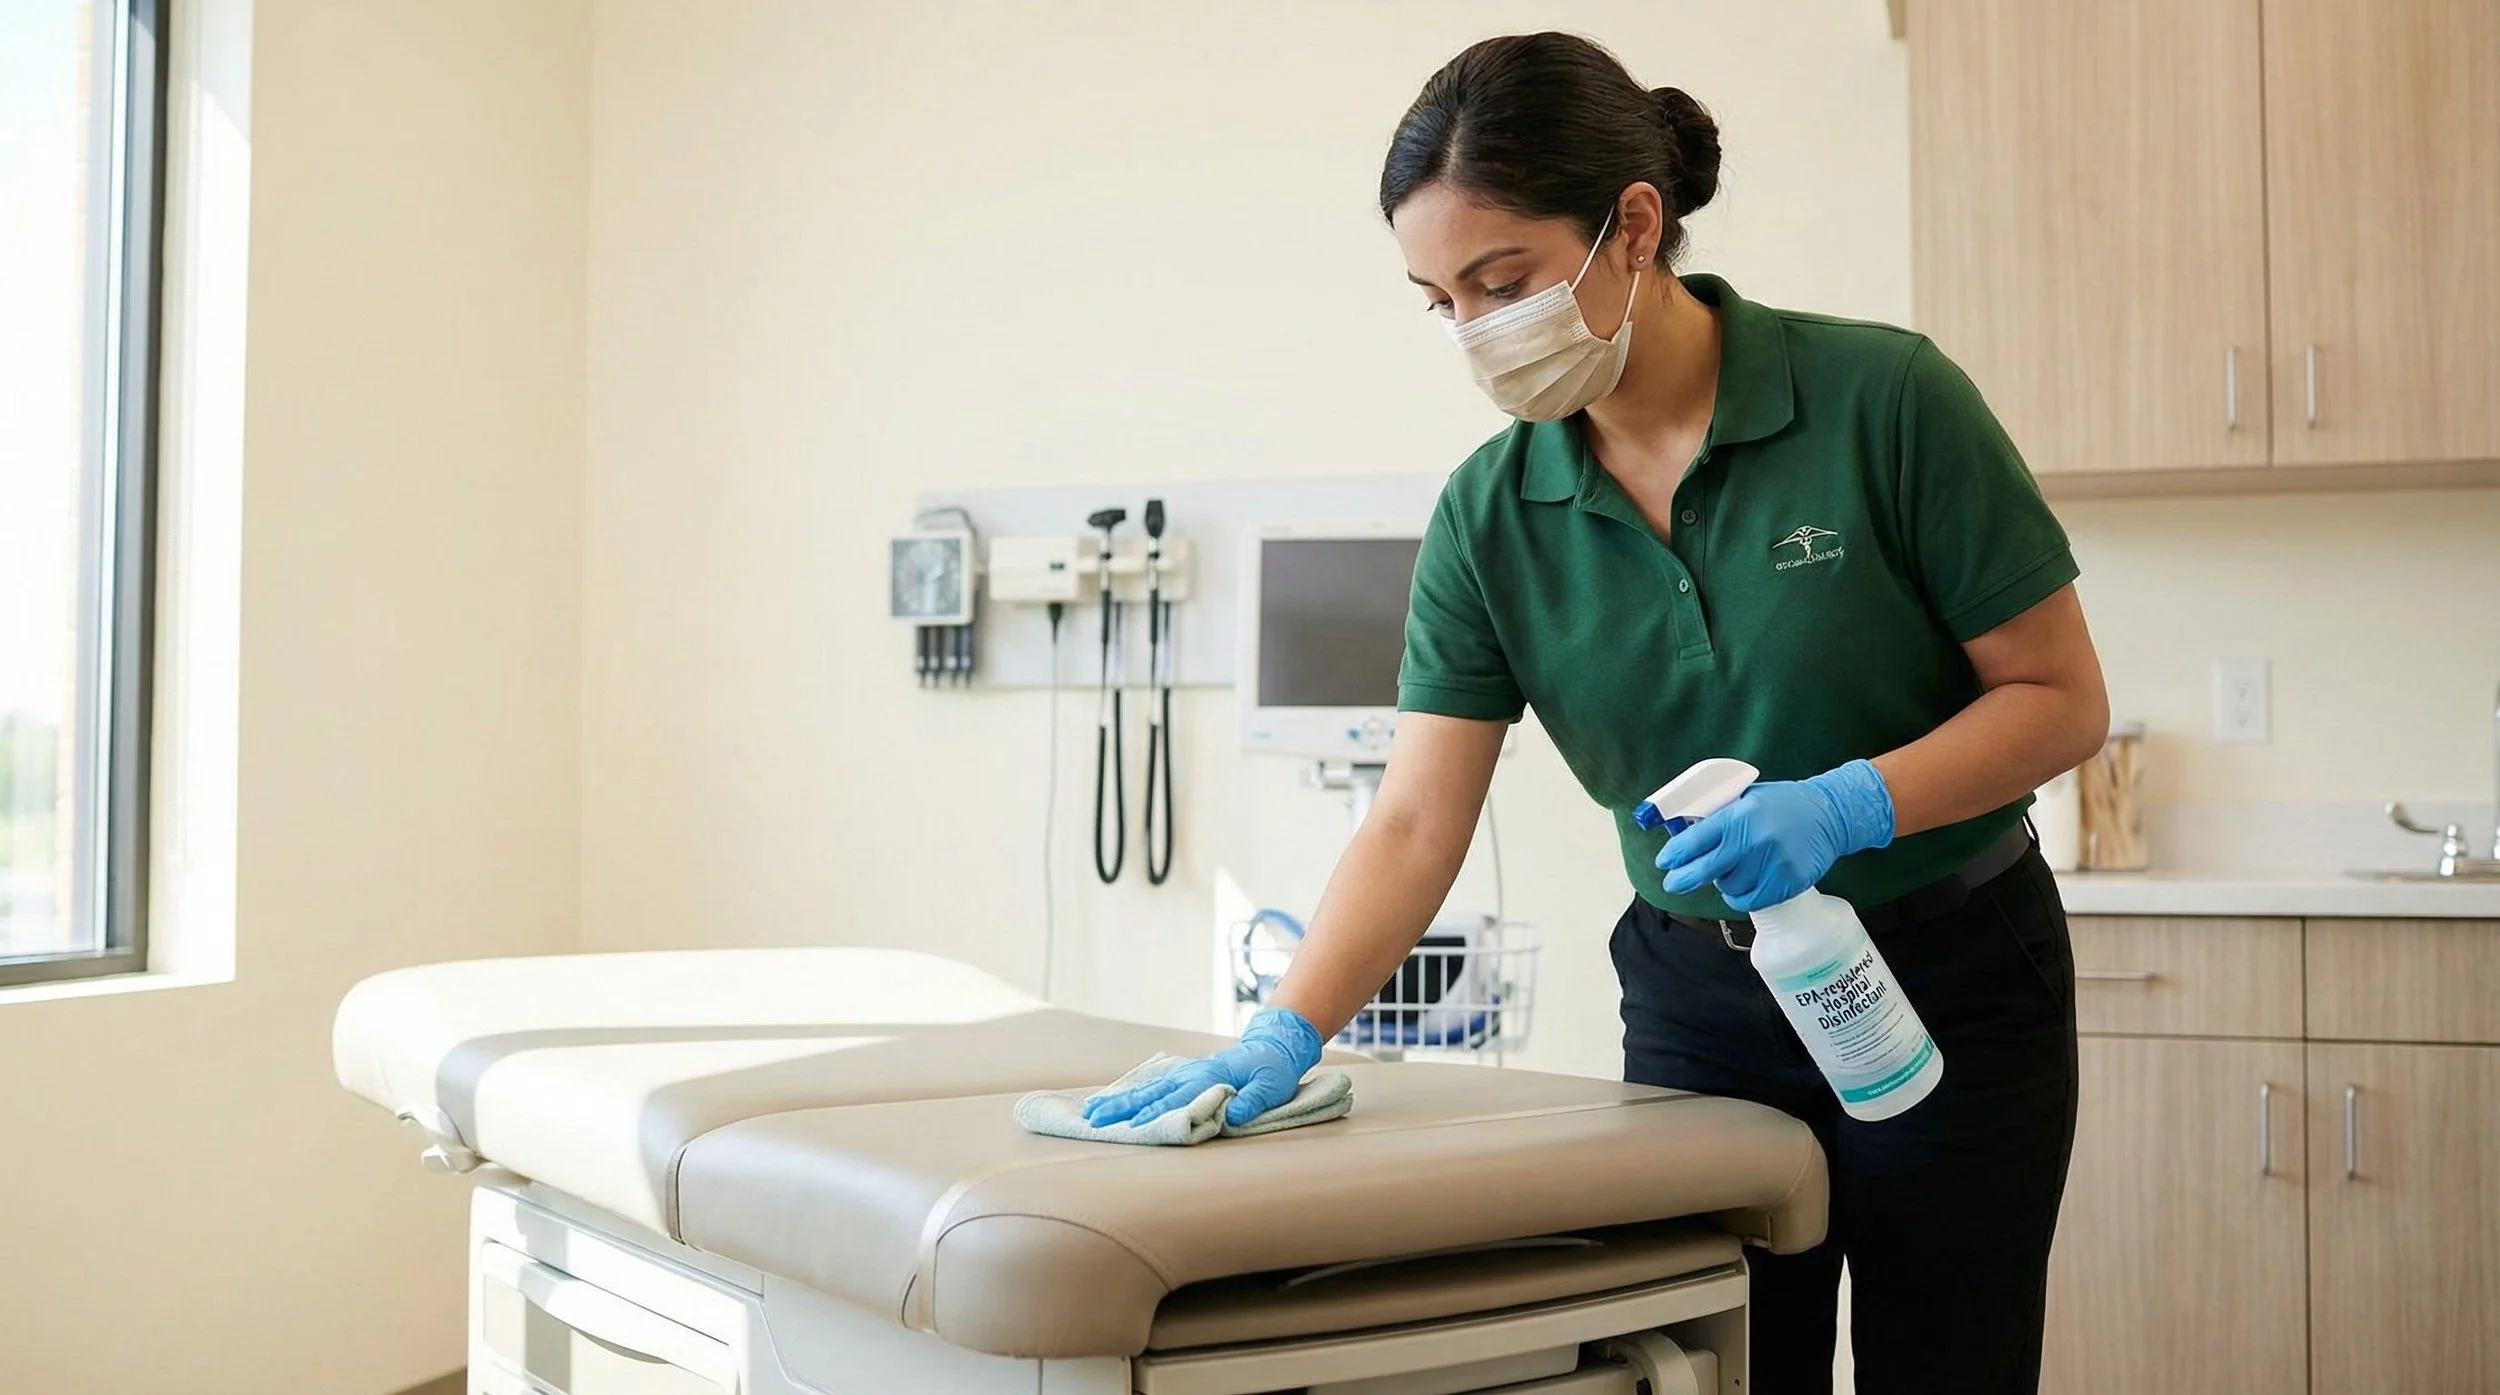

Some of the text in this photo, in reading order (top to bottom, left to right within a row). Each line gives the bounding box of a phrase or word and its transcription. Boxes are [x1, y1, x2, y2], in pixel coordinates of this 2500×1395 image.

[1796, 951, 1874, 1007] EPA-registered
[1821, 975, 1871, 1013] Hospital
[1818, 980, 1888, 1030] Disinfectant
